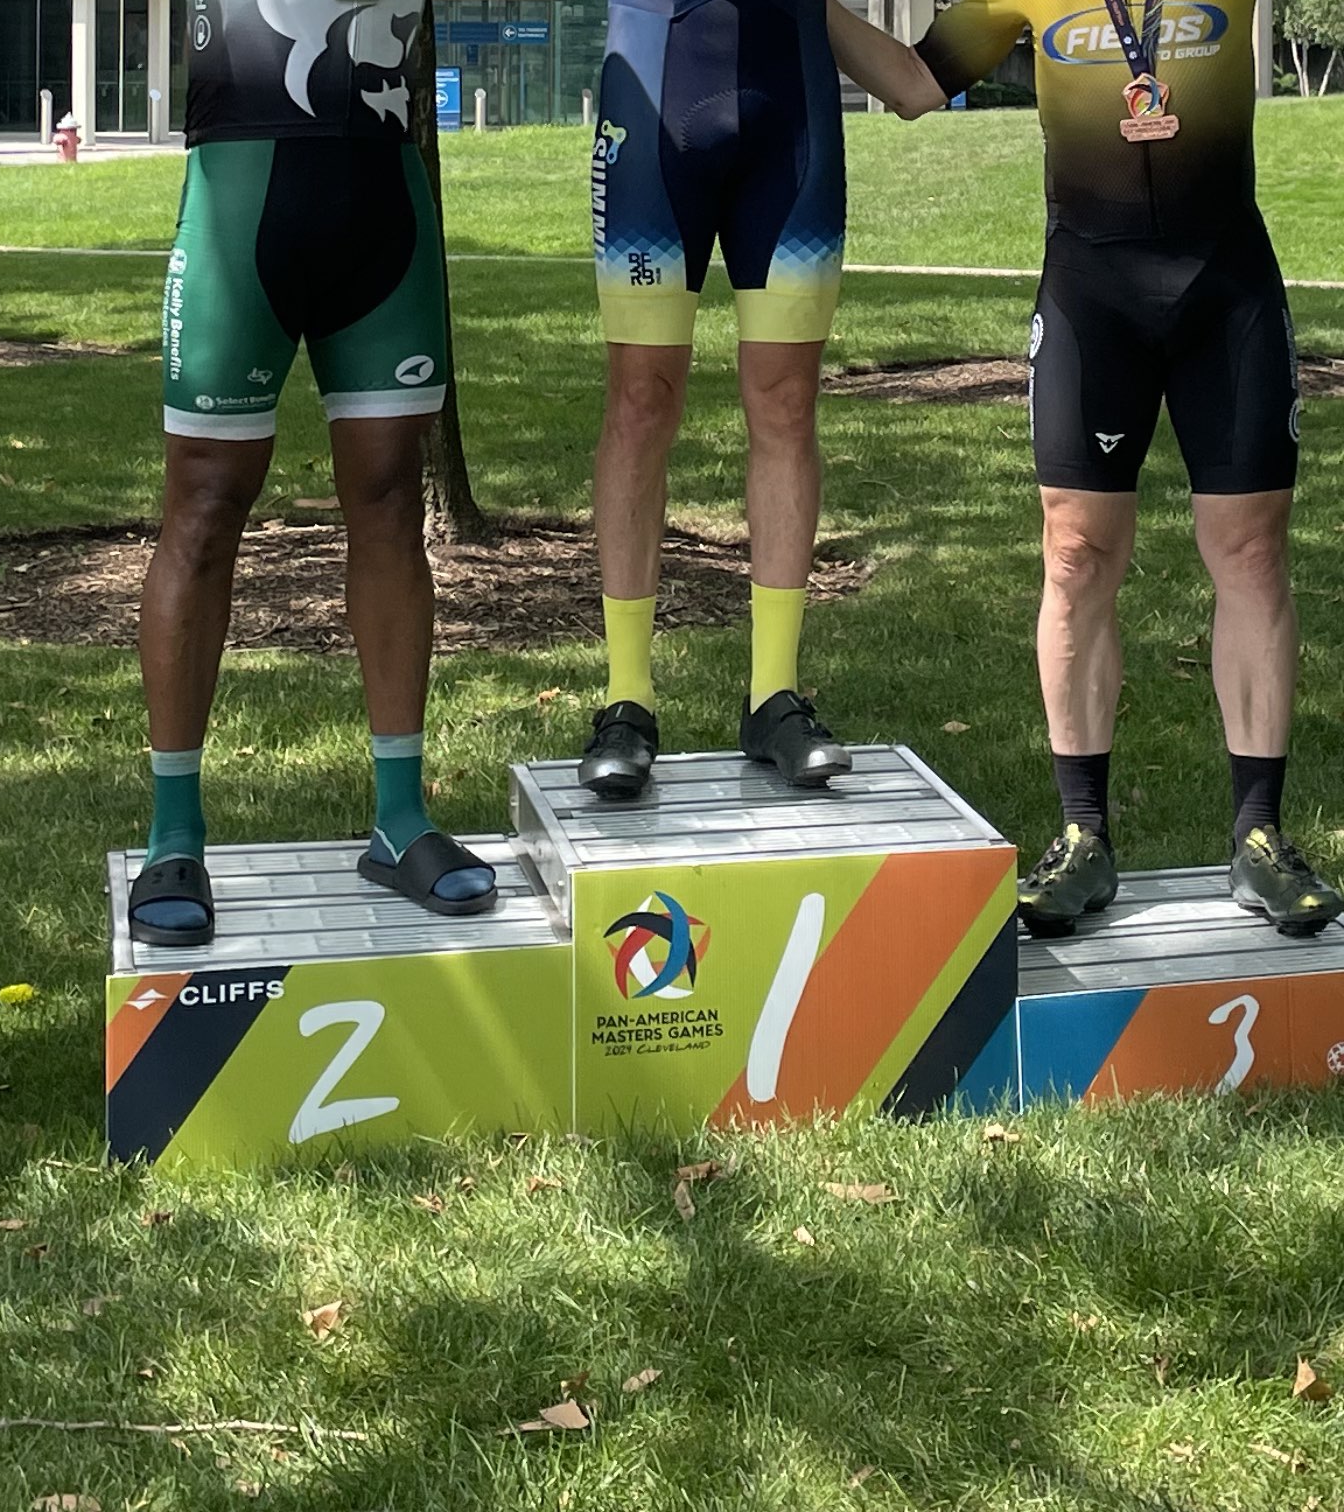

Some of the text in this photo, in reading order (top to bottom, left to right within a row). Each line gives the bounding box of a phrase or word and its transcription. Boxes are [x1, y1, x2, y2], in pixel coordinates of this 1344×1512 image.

[1066, 14, 1205, 55] FIEDS
[1174, 43, 1221, 59] GROUP
[179, 979, 286, 1007] CLIFFS
[747, 892, 826, 1103] 1
[592, 1022, 724, 1045] MASTERS GAMES
[596, 1008, 719, 1029] PAN-AMERICAN
[1208, 994, 1260, 1096] 3
[288, 999, 401, 1145] 2
